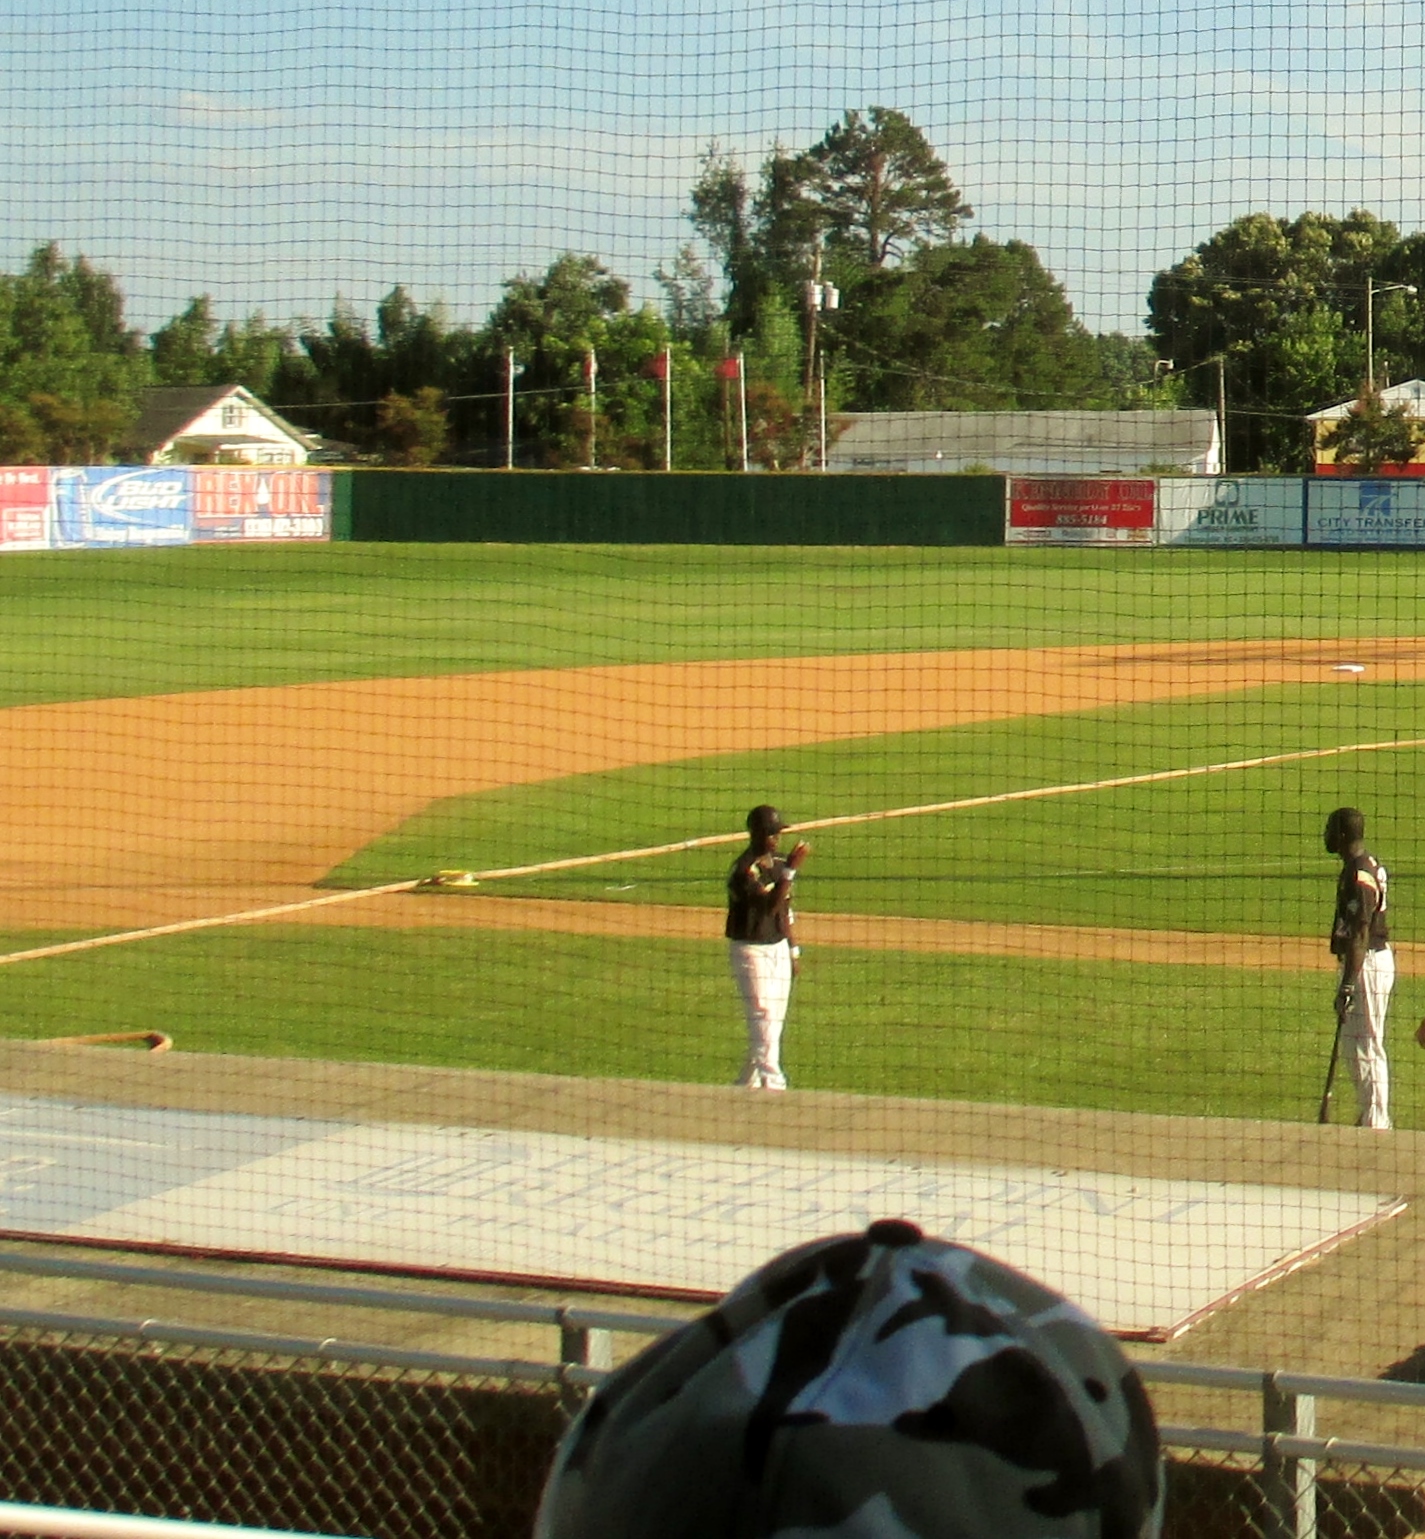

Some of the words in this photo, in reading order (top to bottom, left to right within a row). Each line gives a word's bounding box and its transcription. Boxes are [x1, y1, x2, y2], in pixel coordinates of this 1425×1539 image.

[118, 481, 182, 495] BUD
[196, 472, 258, 517] REX
[105, 495, 187, 511] LIGHT
[1197, 509, 1259, 525] PRIME
[1318, 517, 1351, 528] CITY
